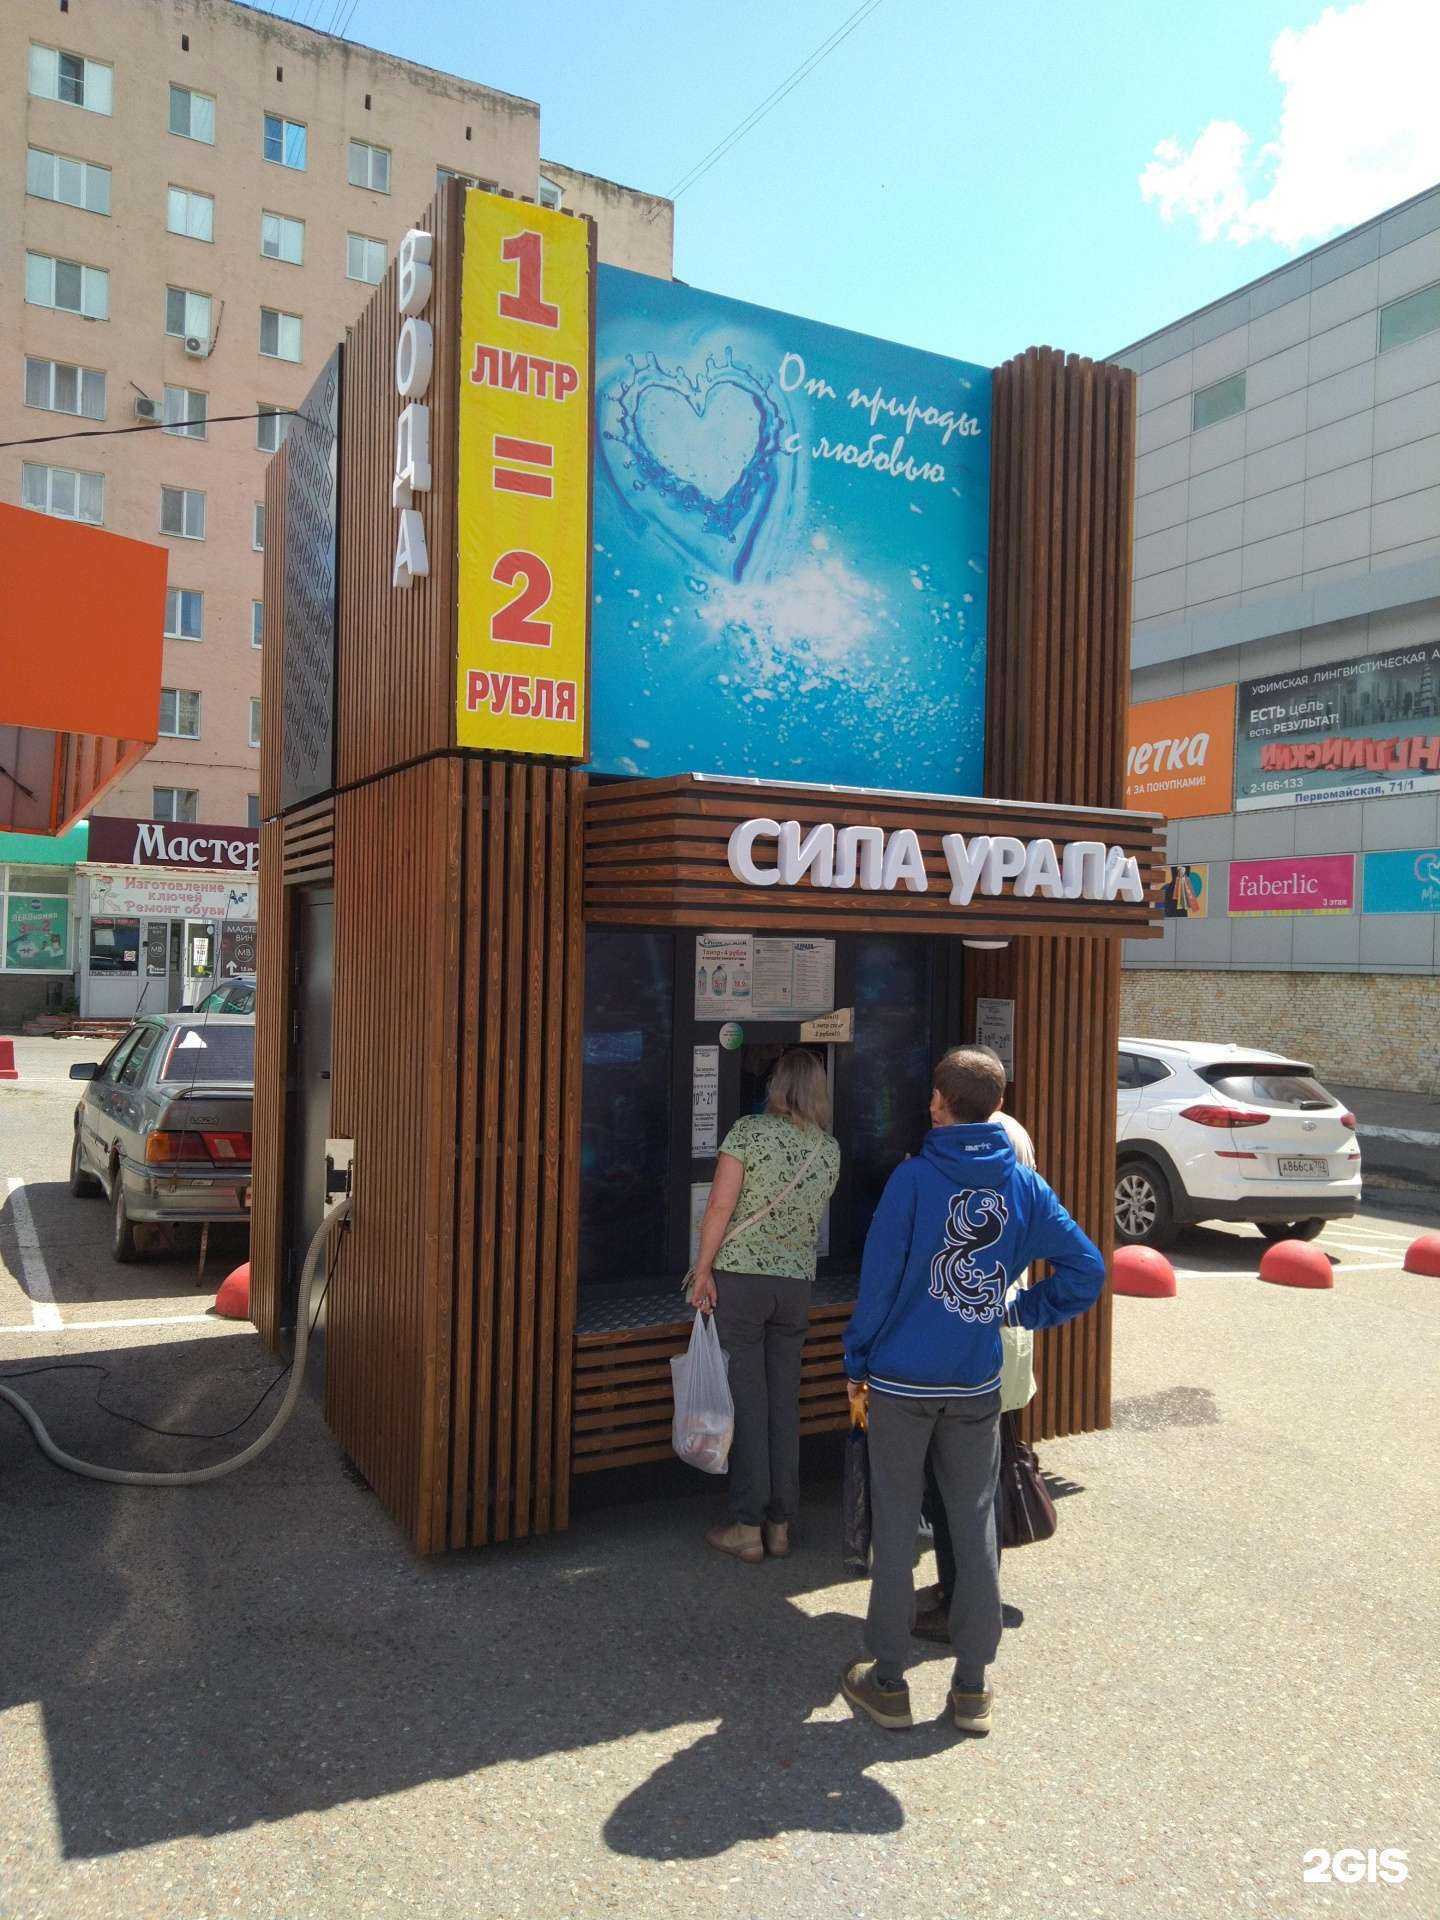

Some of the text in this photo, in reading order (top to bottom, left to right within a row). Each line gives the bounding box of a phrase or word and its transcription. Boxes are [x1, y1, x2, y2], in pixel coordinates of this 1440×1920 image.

[498, 229, 560, 329] 1
[470, 344, 579, 401] ЛИТР
[392, 229, 433, 588] ВОДА
[779, 352, 981, 445] От природы
[784, 432, 945, 482] с любовью
[490, 550, 553, 648] 2
[466, 670, 577, 721] РУБЛЯ
[1251, 675, 1309, 696] УФИМСКАЯ
[1313, 651, 1426, 683] ЛИНГВИСТИЧЕСКАЯ
[1250, 704, 1286, 723] ЕСТЬ
[1250, 713, 1340, 738] есть РЕЗУЛЬТАТ!
[1133, 784, 1145, 795] ЗА
[1146, 776, 1207, 793] ПОКУПКАМИ!
[1250, 778, 1304, 794] 2-166-133
[1295, 780, 1415, 803] Первомайская, 71/1
[124, 876, 225, 893] Изготовление
[727, 818, 1144, 906] СИЛА УРАЛА
[1239, 872, 1318, 897] faberlic
[124, 900, 225, 918] Ремонт обуви
